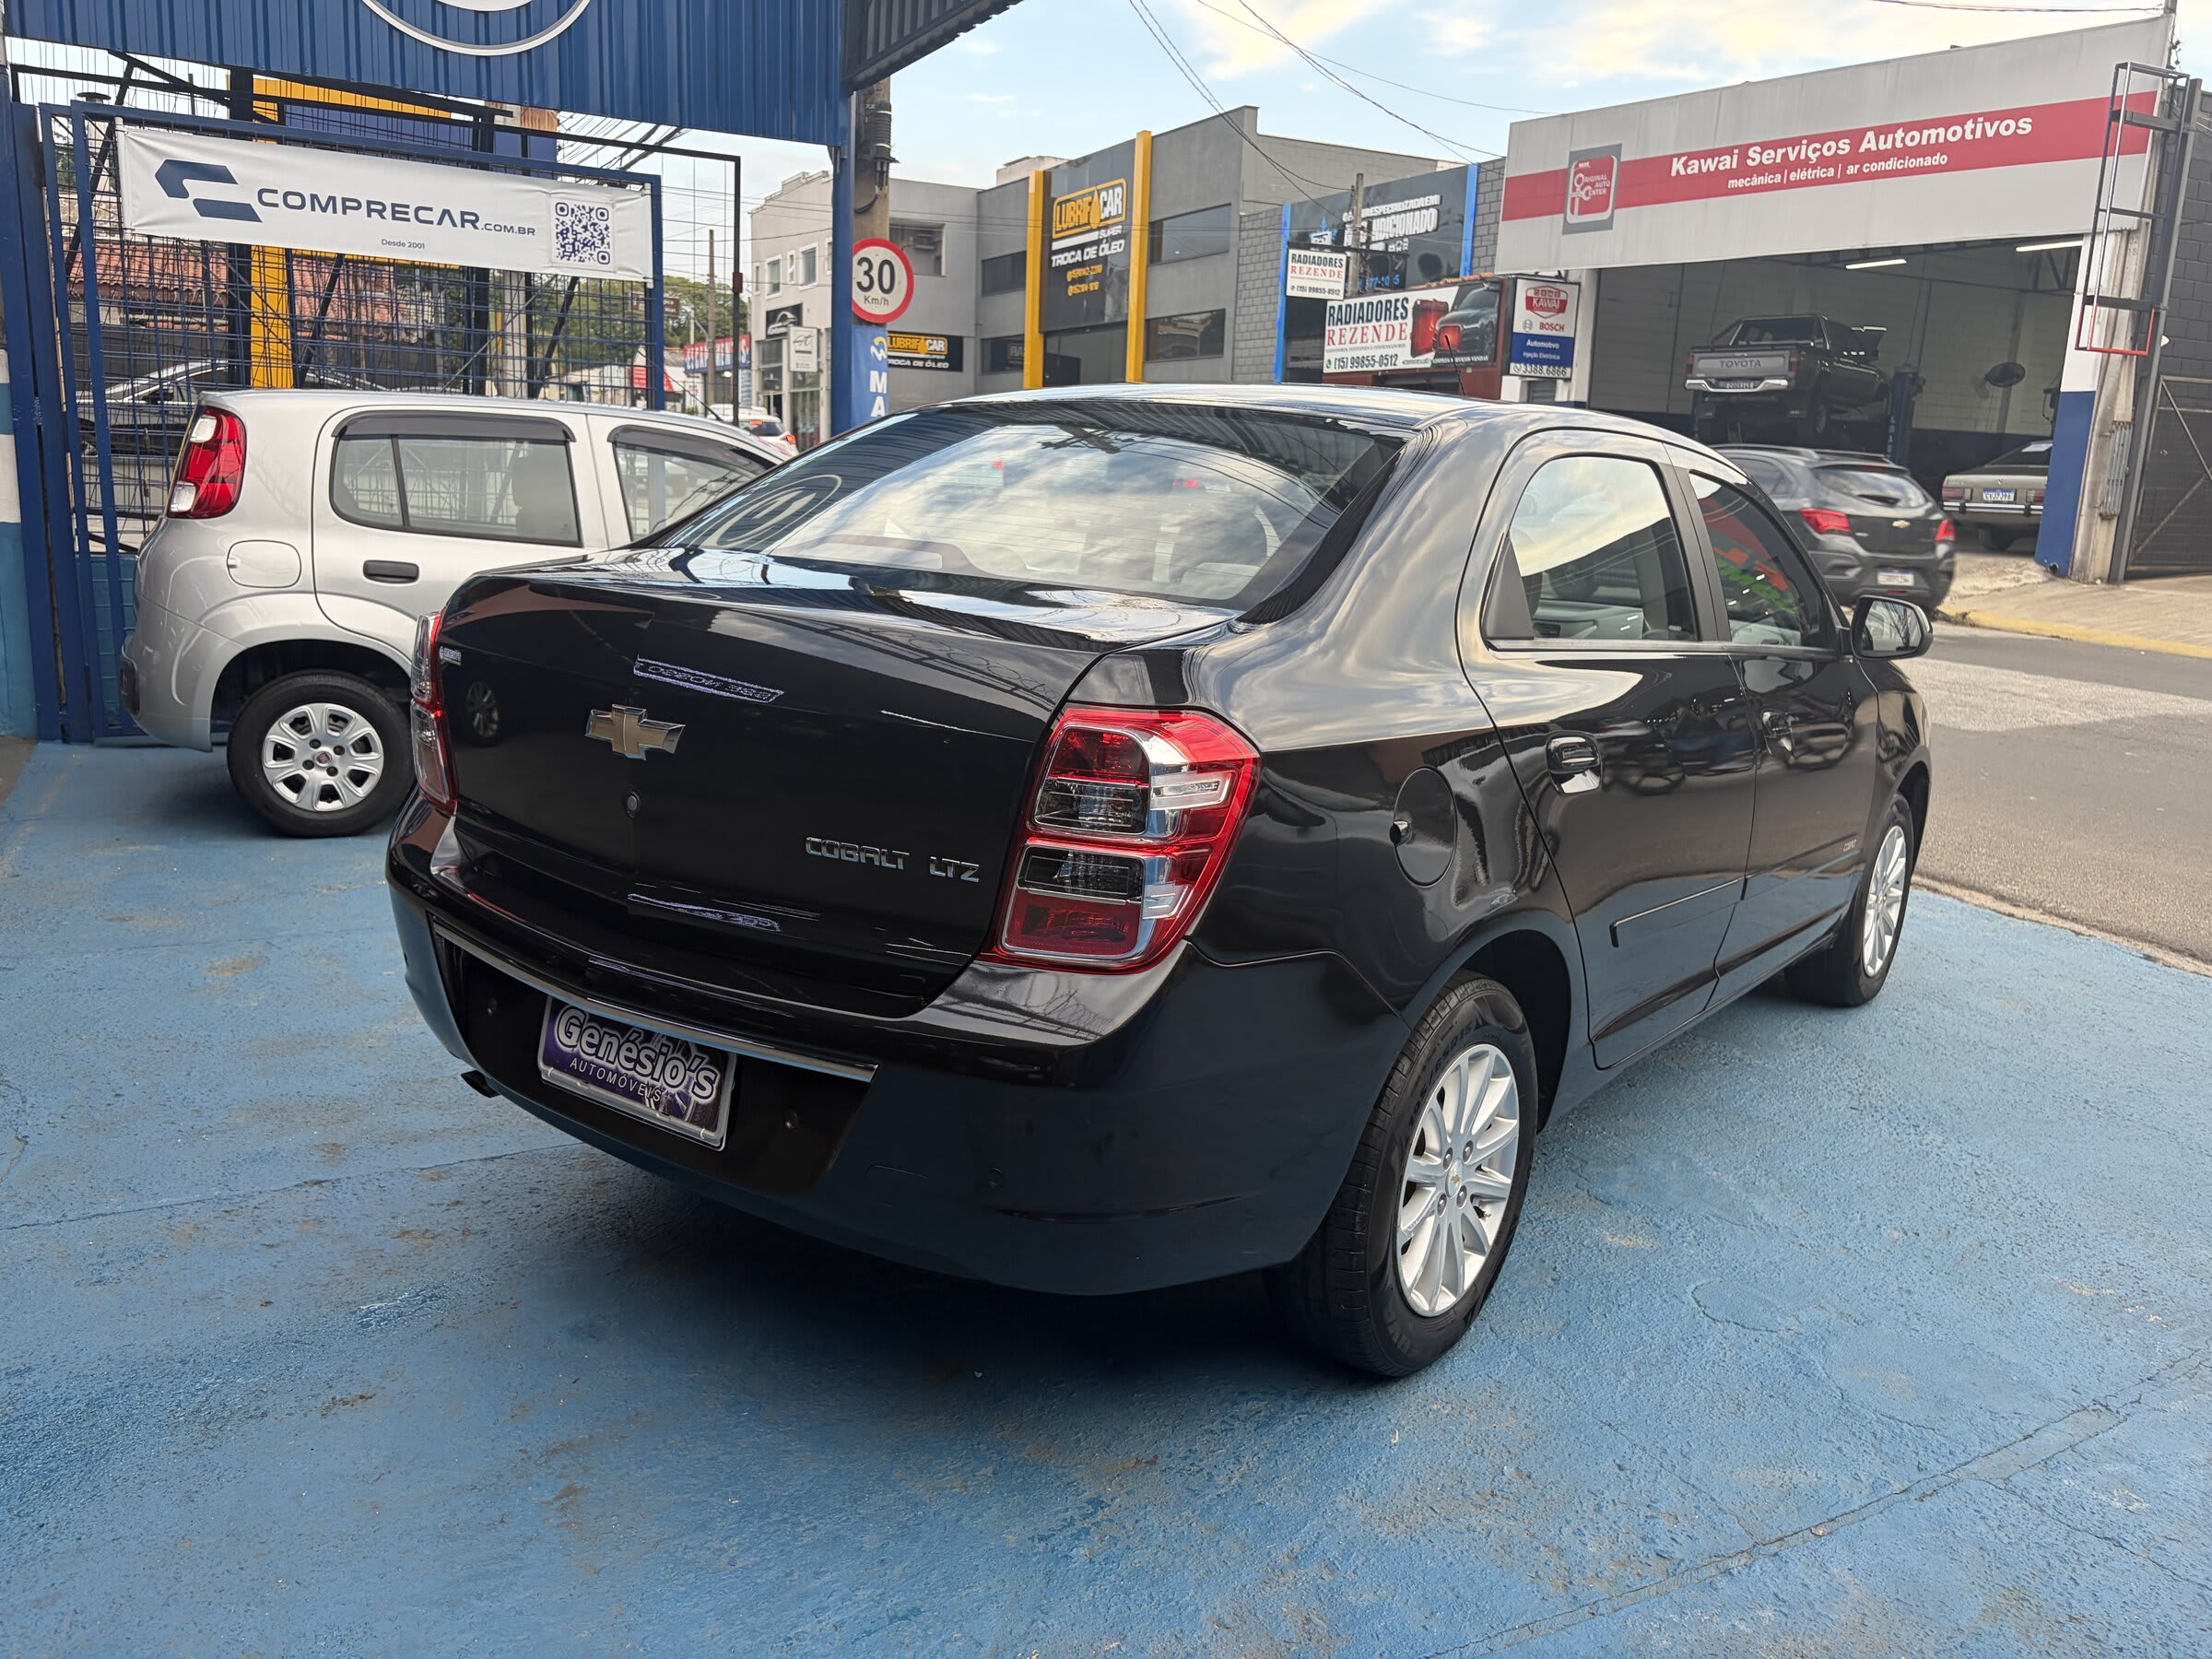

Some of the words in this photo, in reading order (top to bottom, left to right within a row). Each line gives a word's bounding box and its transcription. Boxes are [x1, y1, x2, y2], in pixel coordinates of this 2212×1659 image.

[1670, 149, 1739, 177] Kawai
[1747, 135, 1851, 167] Serviços
[1859, 116, 2033, 153] Automotivos
[1727, 172, 1782, 189] mecânica
[1789, 166, 1835, 181] elétrica
[1846, 163, 1860, 175] ar
[1862, 152, 1947, 173] condicionado
[381, 238, 406, 248] Desde
[407, 240, 426, 250] 2001
[1052, 249, 1082, 267] TROCA
[1083, 245, 1099, 261] DE
[1099, 239, 1125, 257] ÓLEO
[1291, 253, 1343, 268] RADIADORES
[856, 256, 896, 295] 30
[1290, 265, 1343, 279] REZENDE
[864, 295, 889, 306] Km/h
[1532, 298, 1559, 310] KAWAI
[1328, 297, 1409, 326] RADIADORES
[1327, 323, 1408, 346] REZENDE
[1539, 322, 1565, 332] BOSCH
[925, 359, 949, 369] ÓLEO
[1350, 354, 1398, 369] 99855-0512
[1719, 359, 1761, 369] TOYOTA
[805, 836, 910, 870] COBALT
[929, 856, 980, 883] LTZ
[556, 1006, 719, 1100] Genésio's
[570, 1057, 663, 1102] AUTOMÓVEIS
